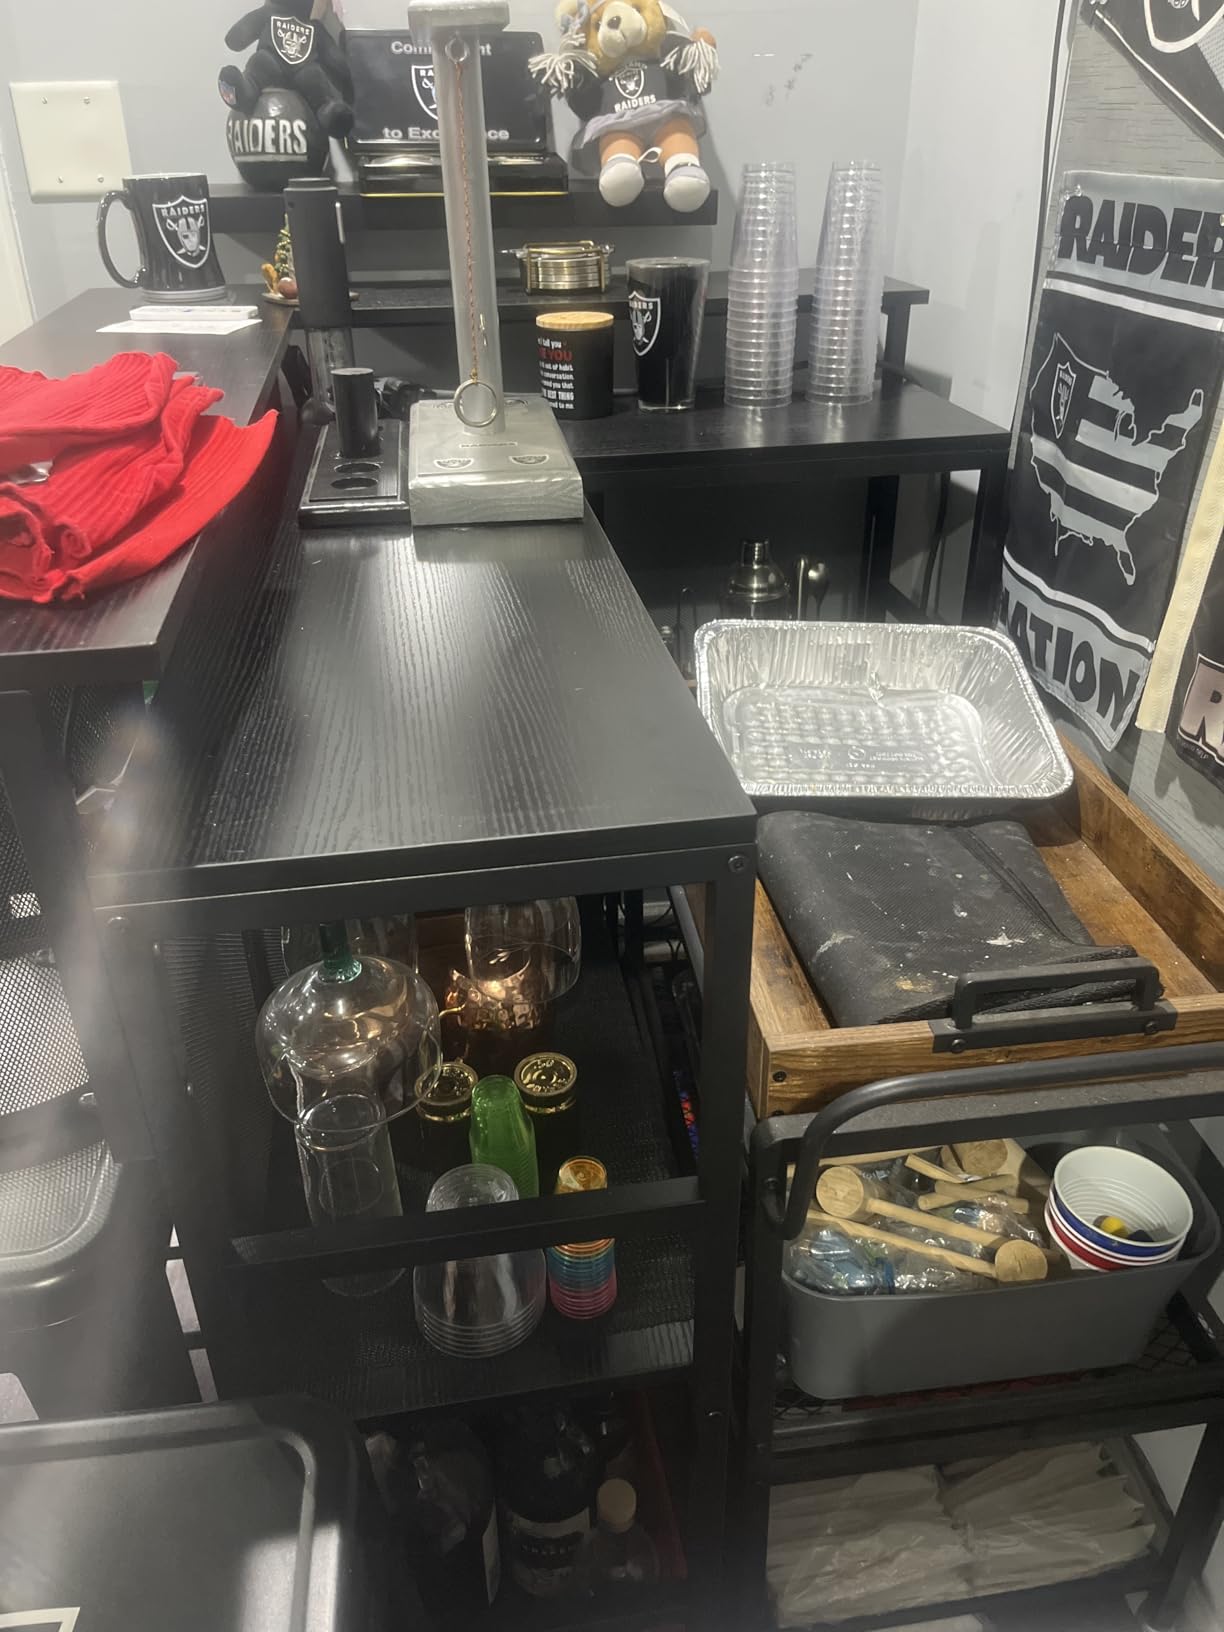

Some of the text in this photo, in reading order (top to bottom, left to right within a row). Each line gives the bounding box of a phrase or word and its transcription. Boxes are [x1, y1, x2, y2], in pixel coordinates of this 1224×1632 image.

[276, 21, 310, 36] RAIDERS
[391, 40, 492, 56] Comnt
[614, 94, 656, 113] RAIDERS
[382, 126, 510, 140] to Excce
[161, 204, 205, 217] RAIDERS
[551, 340, 562, 350] you
